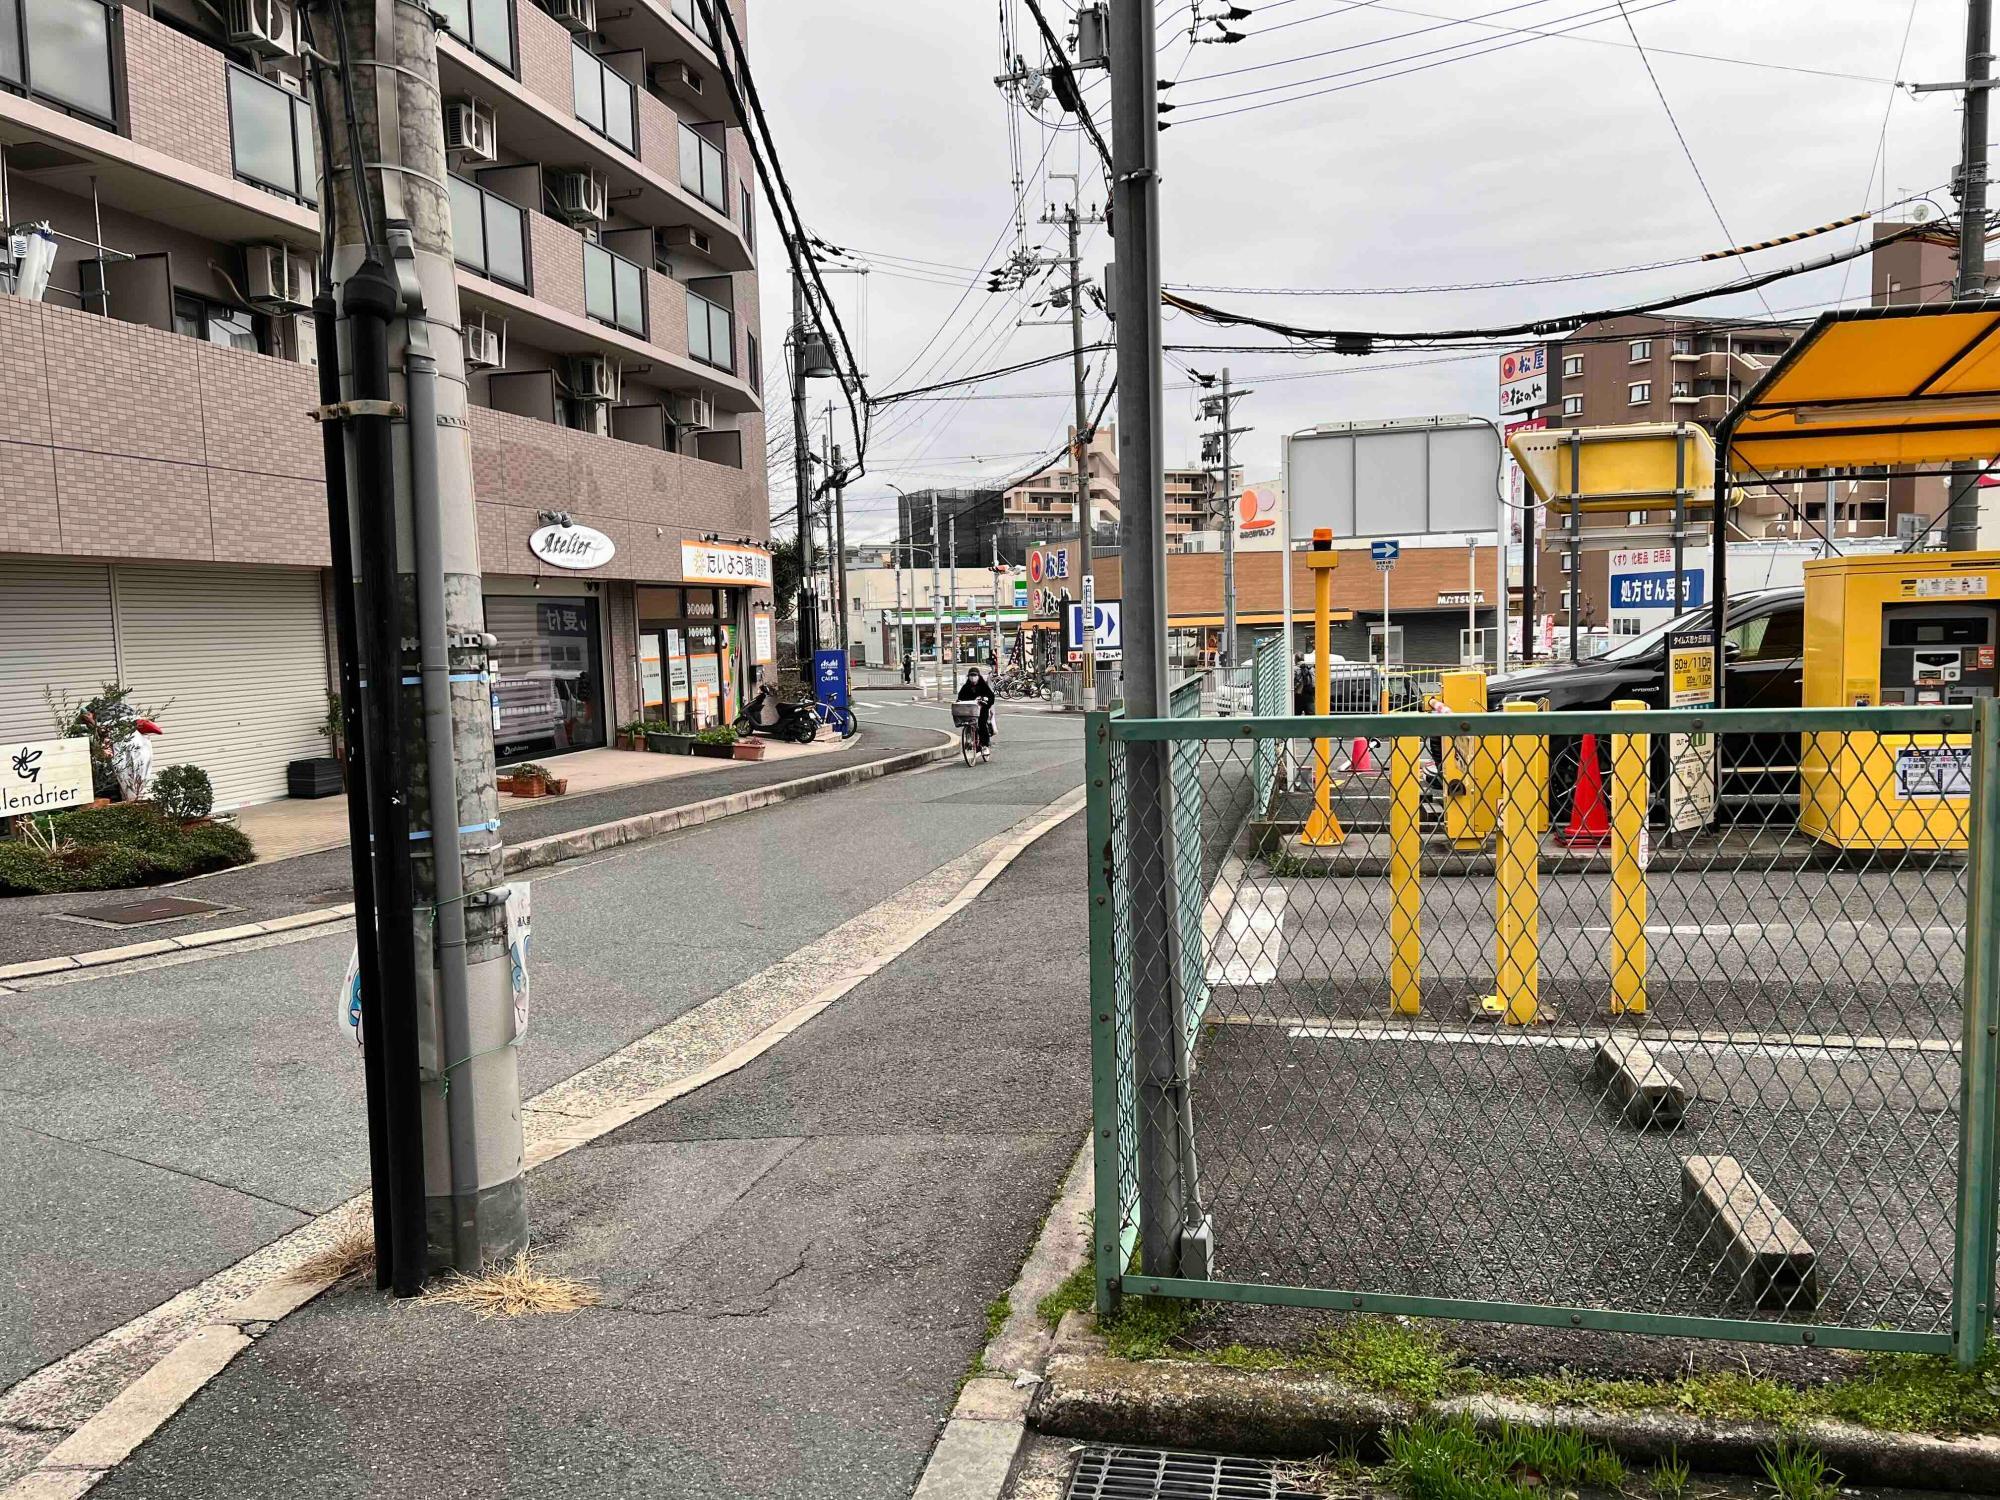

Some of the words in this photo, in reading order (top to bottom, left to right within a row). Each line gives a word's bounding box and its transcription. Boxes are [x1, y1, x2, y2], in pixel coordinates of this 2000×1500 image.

[1519, 350, 1545, 373] 松屋
[1510, 384, 1542, 405] 松のや
[540, 532, 591, 556] Atelier
[1045, 549, 1066, 577] 松屋
[1613, 554, 1627, 566] くすり
[1632, 551, 1649, 565] 化粧品
[1653, 549, 1671, 563] 日用品
[0, 783, 78, 810] lendrier
